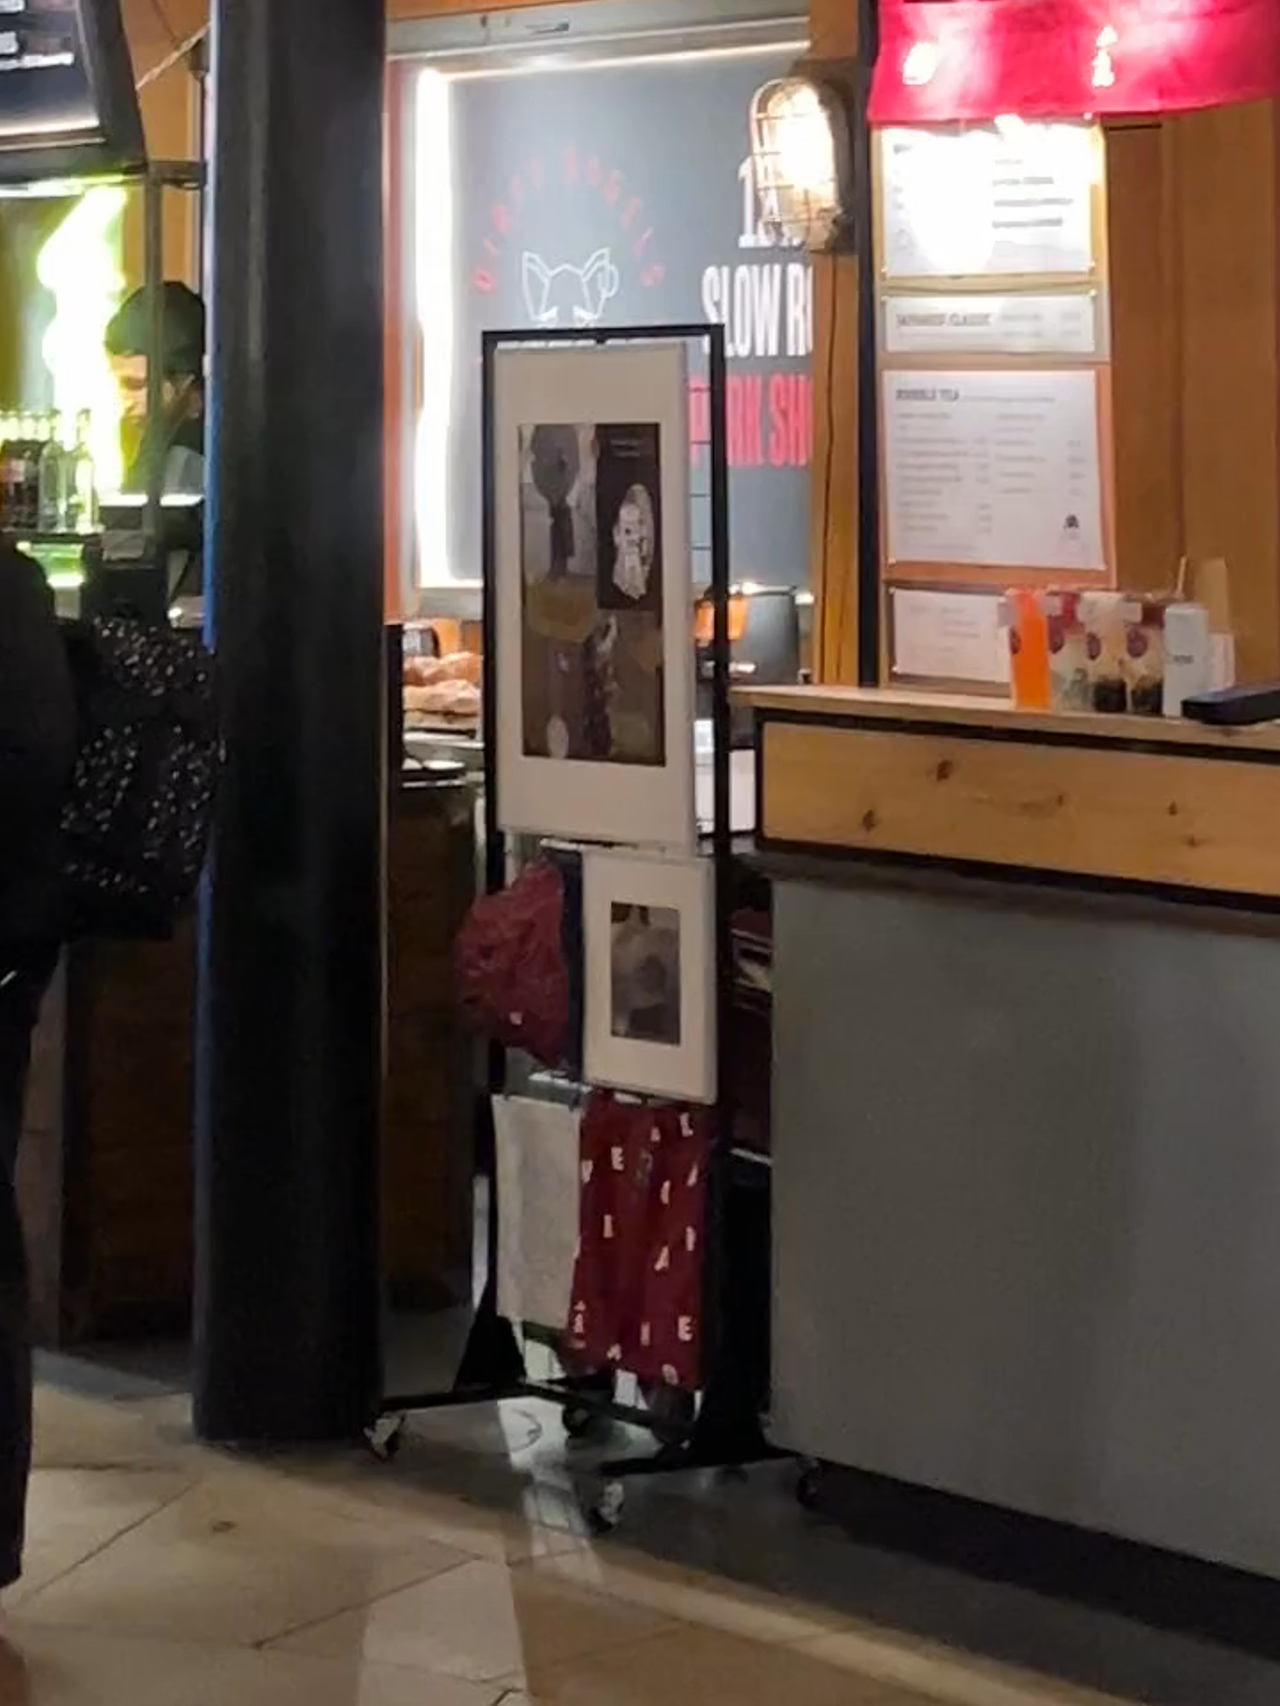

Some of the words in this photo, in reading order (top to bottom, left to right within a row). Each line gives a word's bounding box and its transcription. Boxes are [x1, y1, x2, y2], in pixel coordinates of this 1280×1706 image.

[702, 264, 781, 357] SLOW
[786, 263, 812, 356] R
[689, 374, 764, 466] PRK
